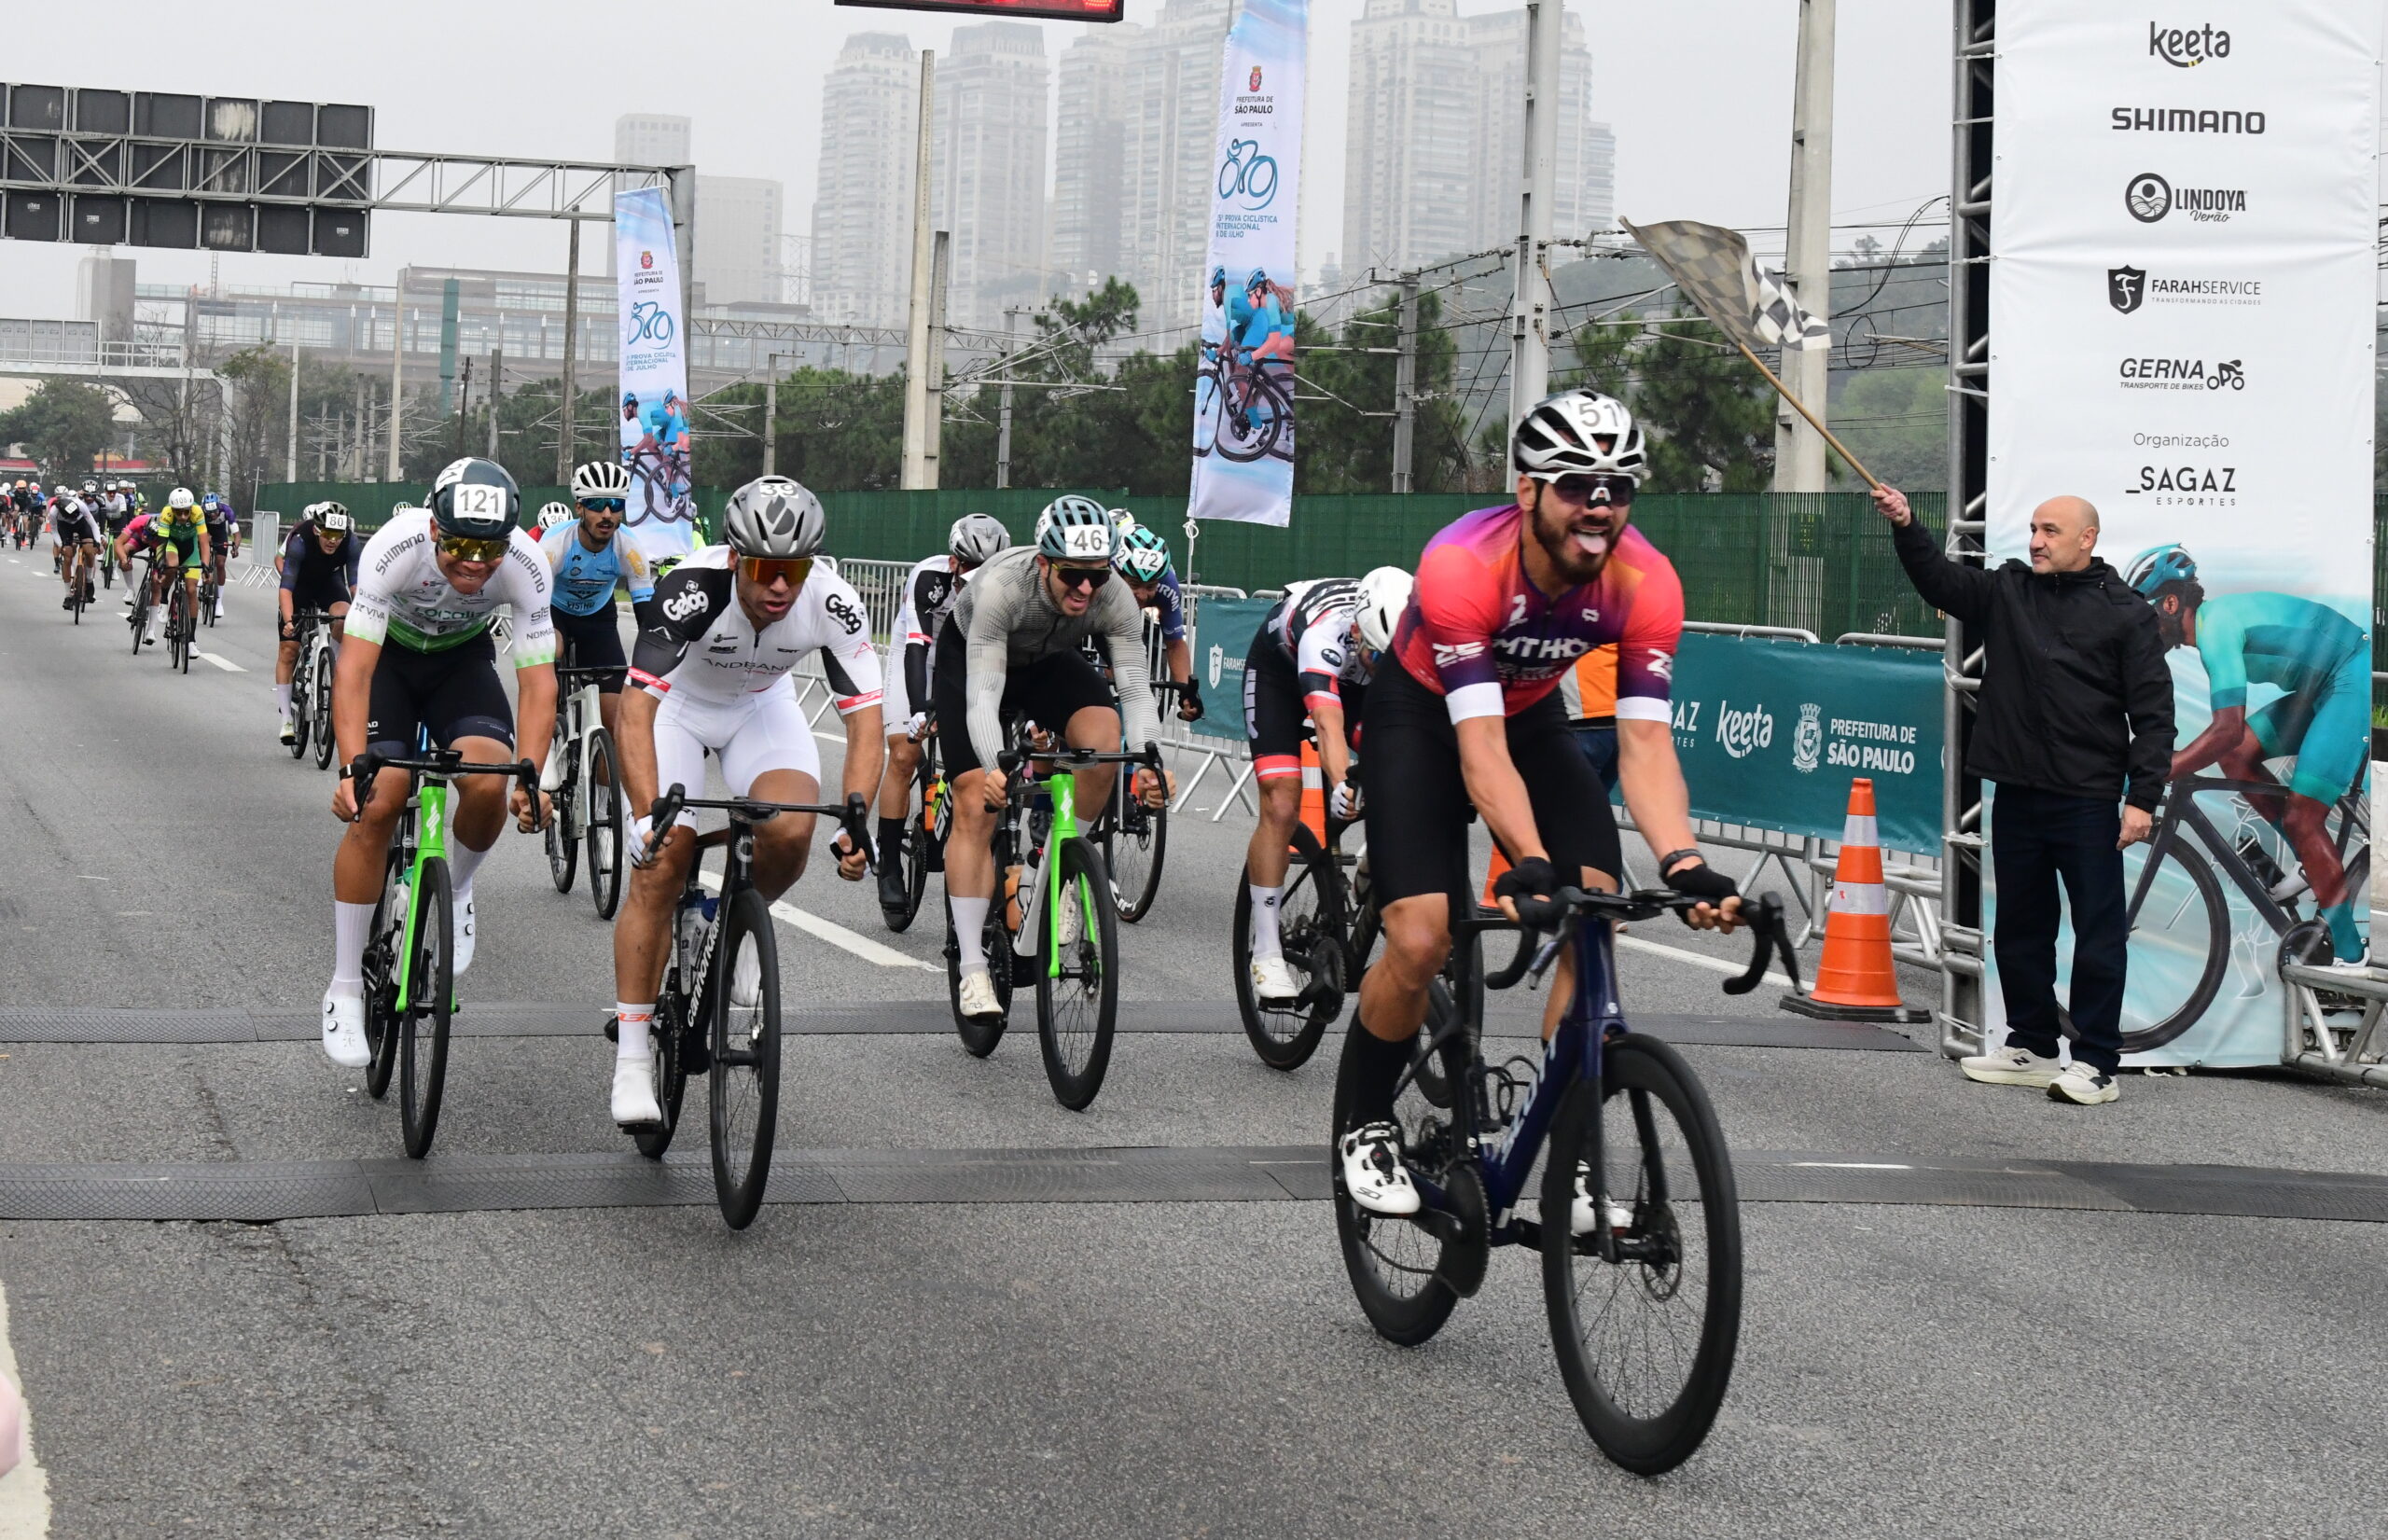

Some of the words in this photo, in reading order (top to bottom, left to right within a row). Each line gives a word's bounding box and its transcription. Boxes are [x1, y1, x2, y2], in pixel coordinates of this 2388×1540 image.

[2149, 21, 2230, 68] keeta
[1234, 104, 1248, 114] SÃO
[1249, 105, 1273, 114] PAULO
[2112, 107, 2265, 133] SHIMANO
[2175, 188, 2246, 213] LINDOYA
[2190, 210, 2230, 223] Verão
[2151, 279, 2261, 295] FARAHSERVICE
[2120, 358, 2204, 380] GERNA
[2120, 382, 2169, 390] TRANSPORTE
[1578, 402, 1618, 427] 51
[2133, 432, 2229, 449] Organização
[760, 483, 798, 495] 39
[460, 489, 498, 514] 121
[2156, 496, 2236, 506] ESPORTES
[329, 516, 344, 527] 80
[1074, 529, 1103, 551] 46
[375, 533, 425, 576] SHIMANO
[1139, 550, 1159, 568] 72
[508, 545, 546, 594] HIMANO
[701, 658, 791, 671] ANDBAN
[1668, 699, 1701, 731] AZ
[1716, 701, 1773, 758] keeta
[1830, 718, 1897, 742] PREFEITURA
[1900, 726, 1917, 744] DE
[1827, 739, 1860, 768] SÃO
[1862, 745, 1915, 775] PAULO
